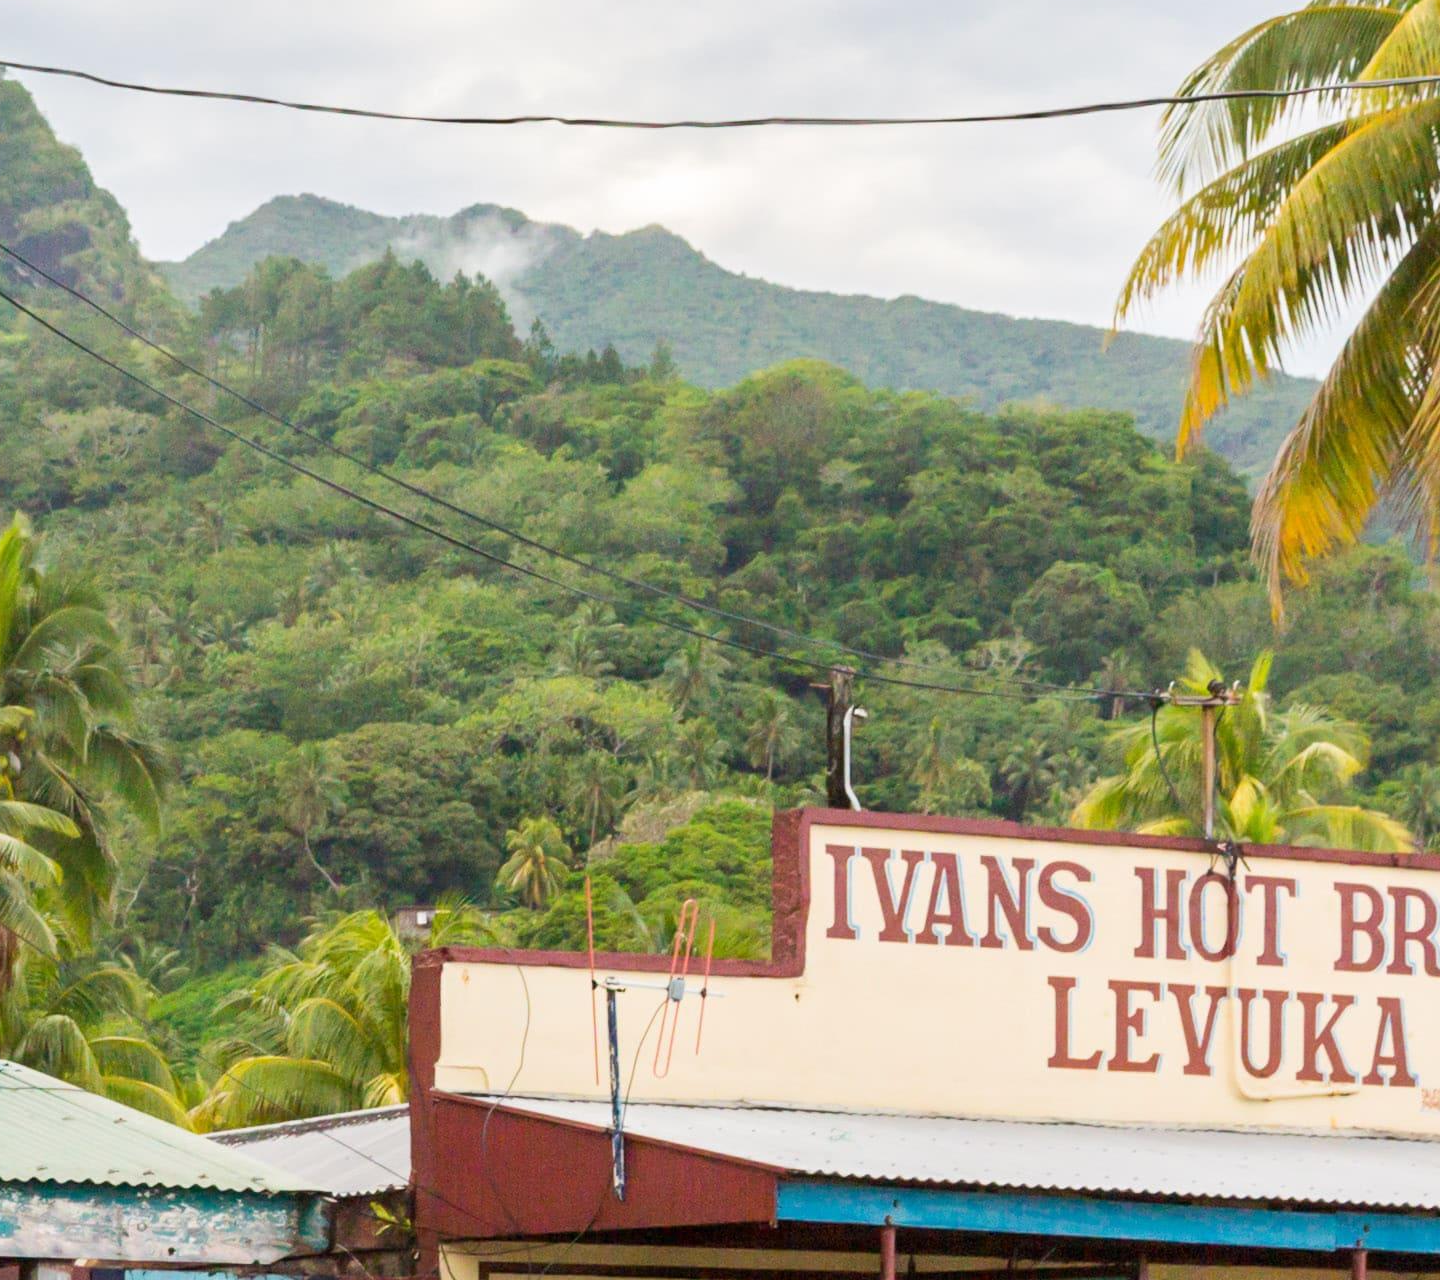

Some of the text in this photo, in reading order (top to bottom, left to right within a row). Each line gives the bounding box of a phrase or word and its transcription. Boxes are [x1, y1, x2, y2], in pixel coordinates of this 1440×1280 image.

[825, 844, 1095, 954] IVANS
[1133, 867, 1300, 966] HOT
[1047, 975, 1419, 1087] LEVUKA
